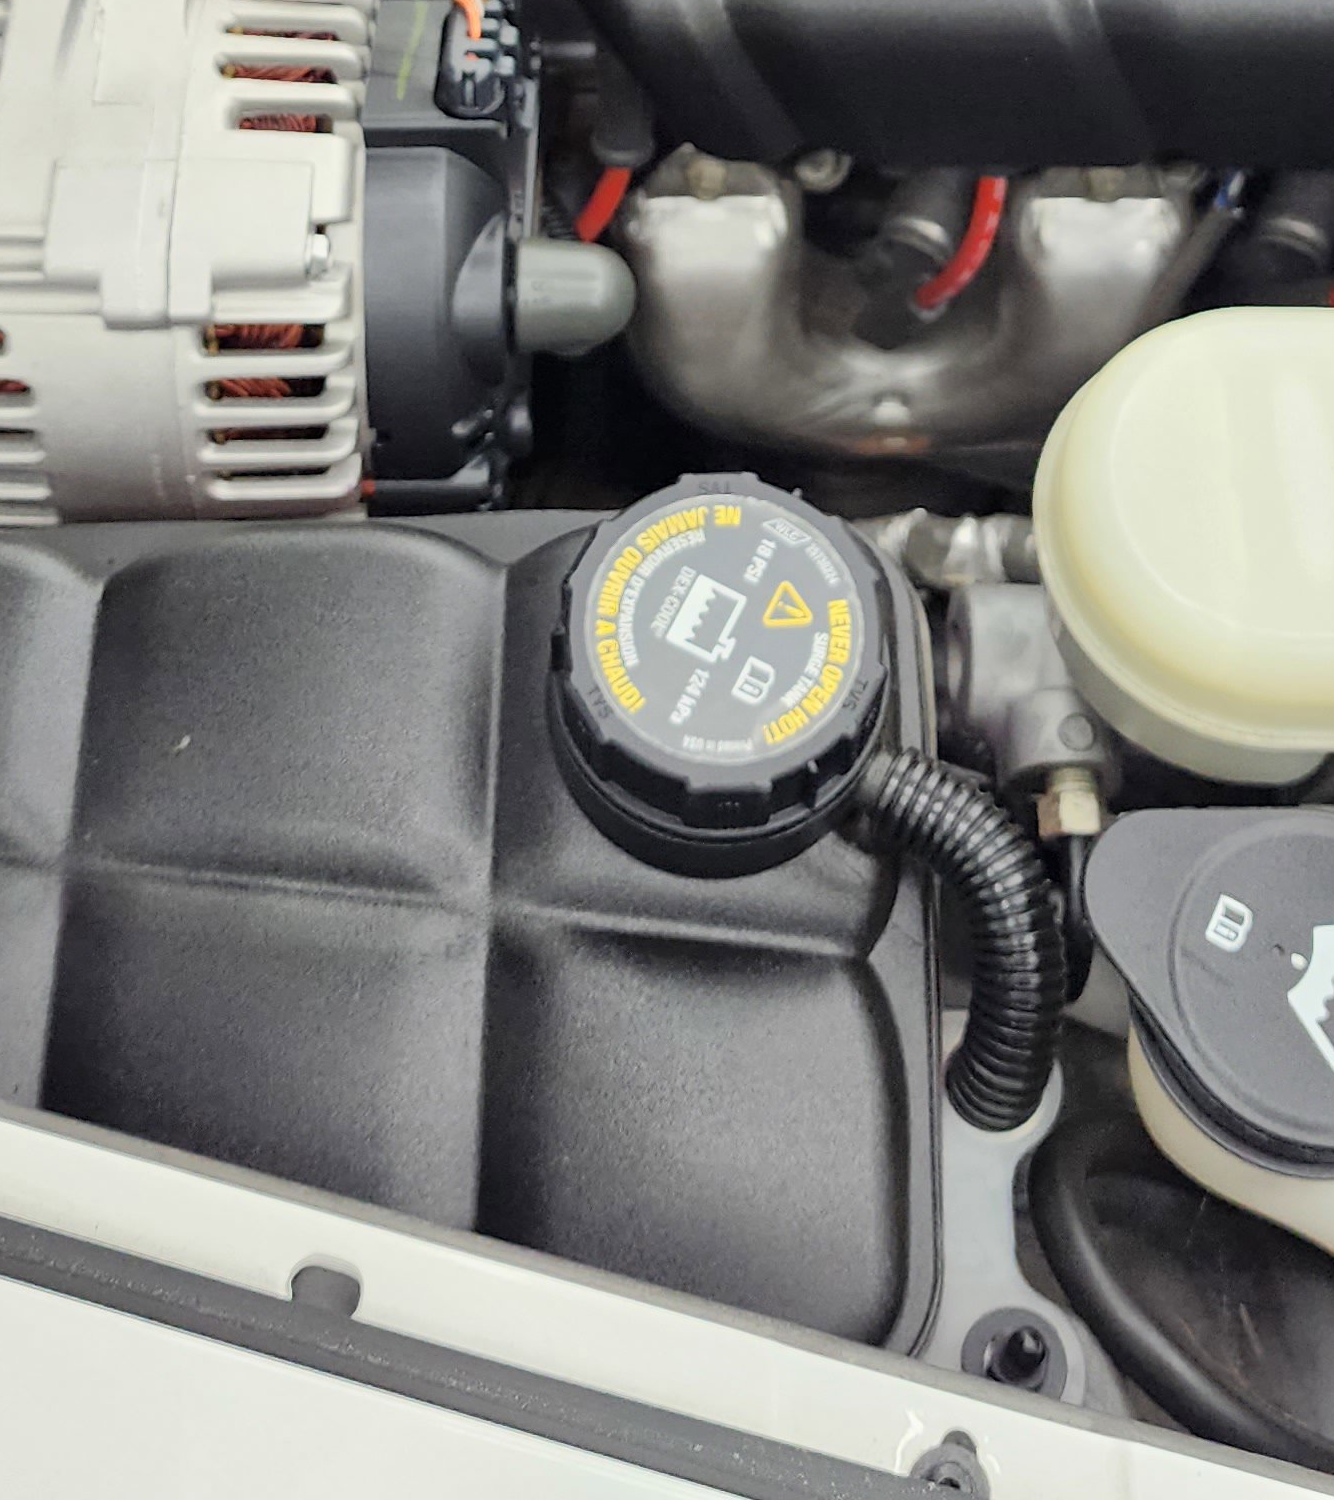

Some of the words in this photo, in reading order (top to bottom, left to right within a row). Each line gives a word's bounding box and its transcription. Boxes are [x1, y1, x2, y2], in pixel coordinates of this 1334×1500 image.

[636, 505, 709, 554] JAMAIS
[714, 504, 742, 526] NE
[743, 555, 768, 585] PSI
[756, 539, 777, 559] 18
[597, 546, 643, 617] OUVRIR
[827, 599, 851, 665] NEVER
[596, 638, 647, 713] CHAUD!
[804, 631, 829, 677] SURGE
[685, 668, 710, 698] 124
[779, 674, 817, 708] TANK
[801, 663, 843, 715] OPEN
[763, 705, 810, 745] HOT!
